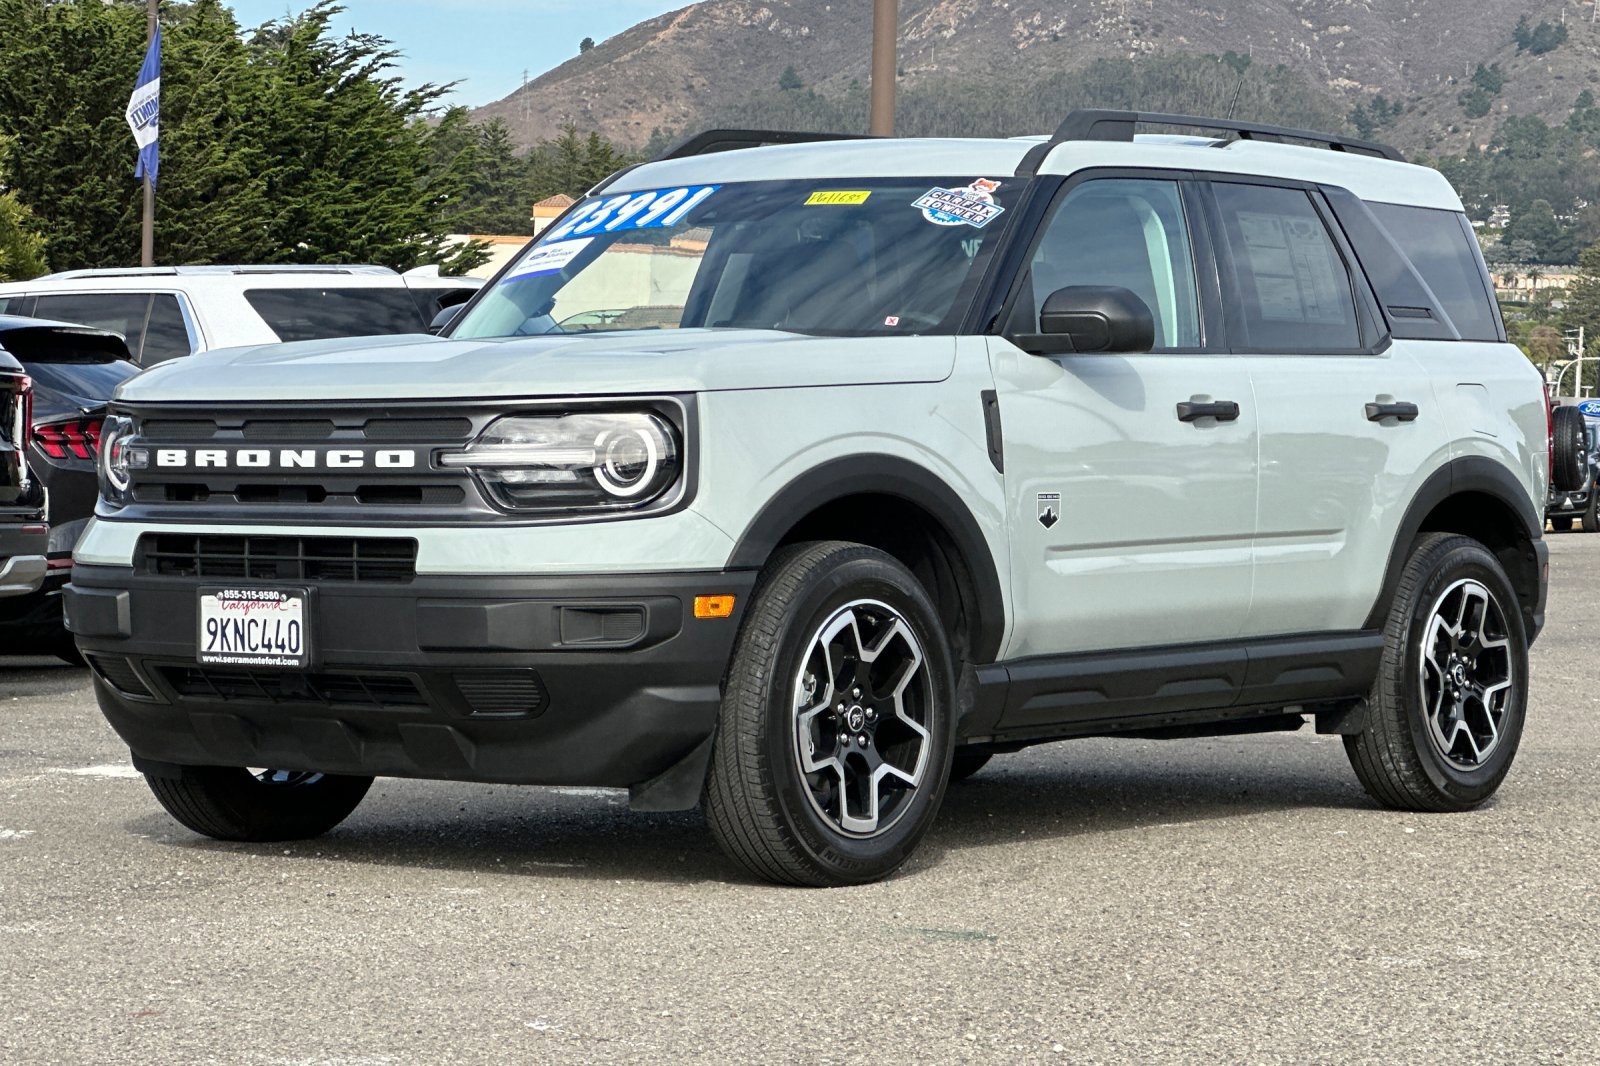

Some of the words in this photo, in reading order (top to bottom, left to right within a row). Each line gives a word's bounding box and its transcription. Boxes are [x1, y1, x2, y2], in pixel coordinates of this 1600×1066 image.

[931, 191, 993, 216] CARFAX
[931, 202, 986, 223] OWNER
[545, 187, 714, 241] 23991
[157, 449, 415, 468] BRONCO
[223, 589, 280, 600] 855-315-9580
[221, 599, 288, 616] California
[206, 617, 300, 654] 9KNC440
[202, 654, 299, 666] www.serramonteford.com
